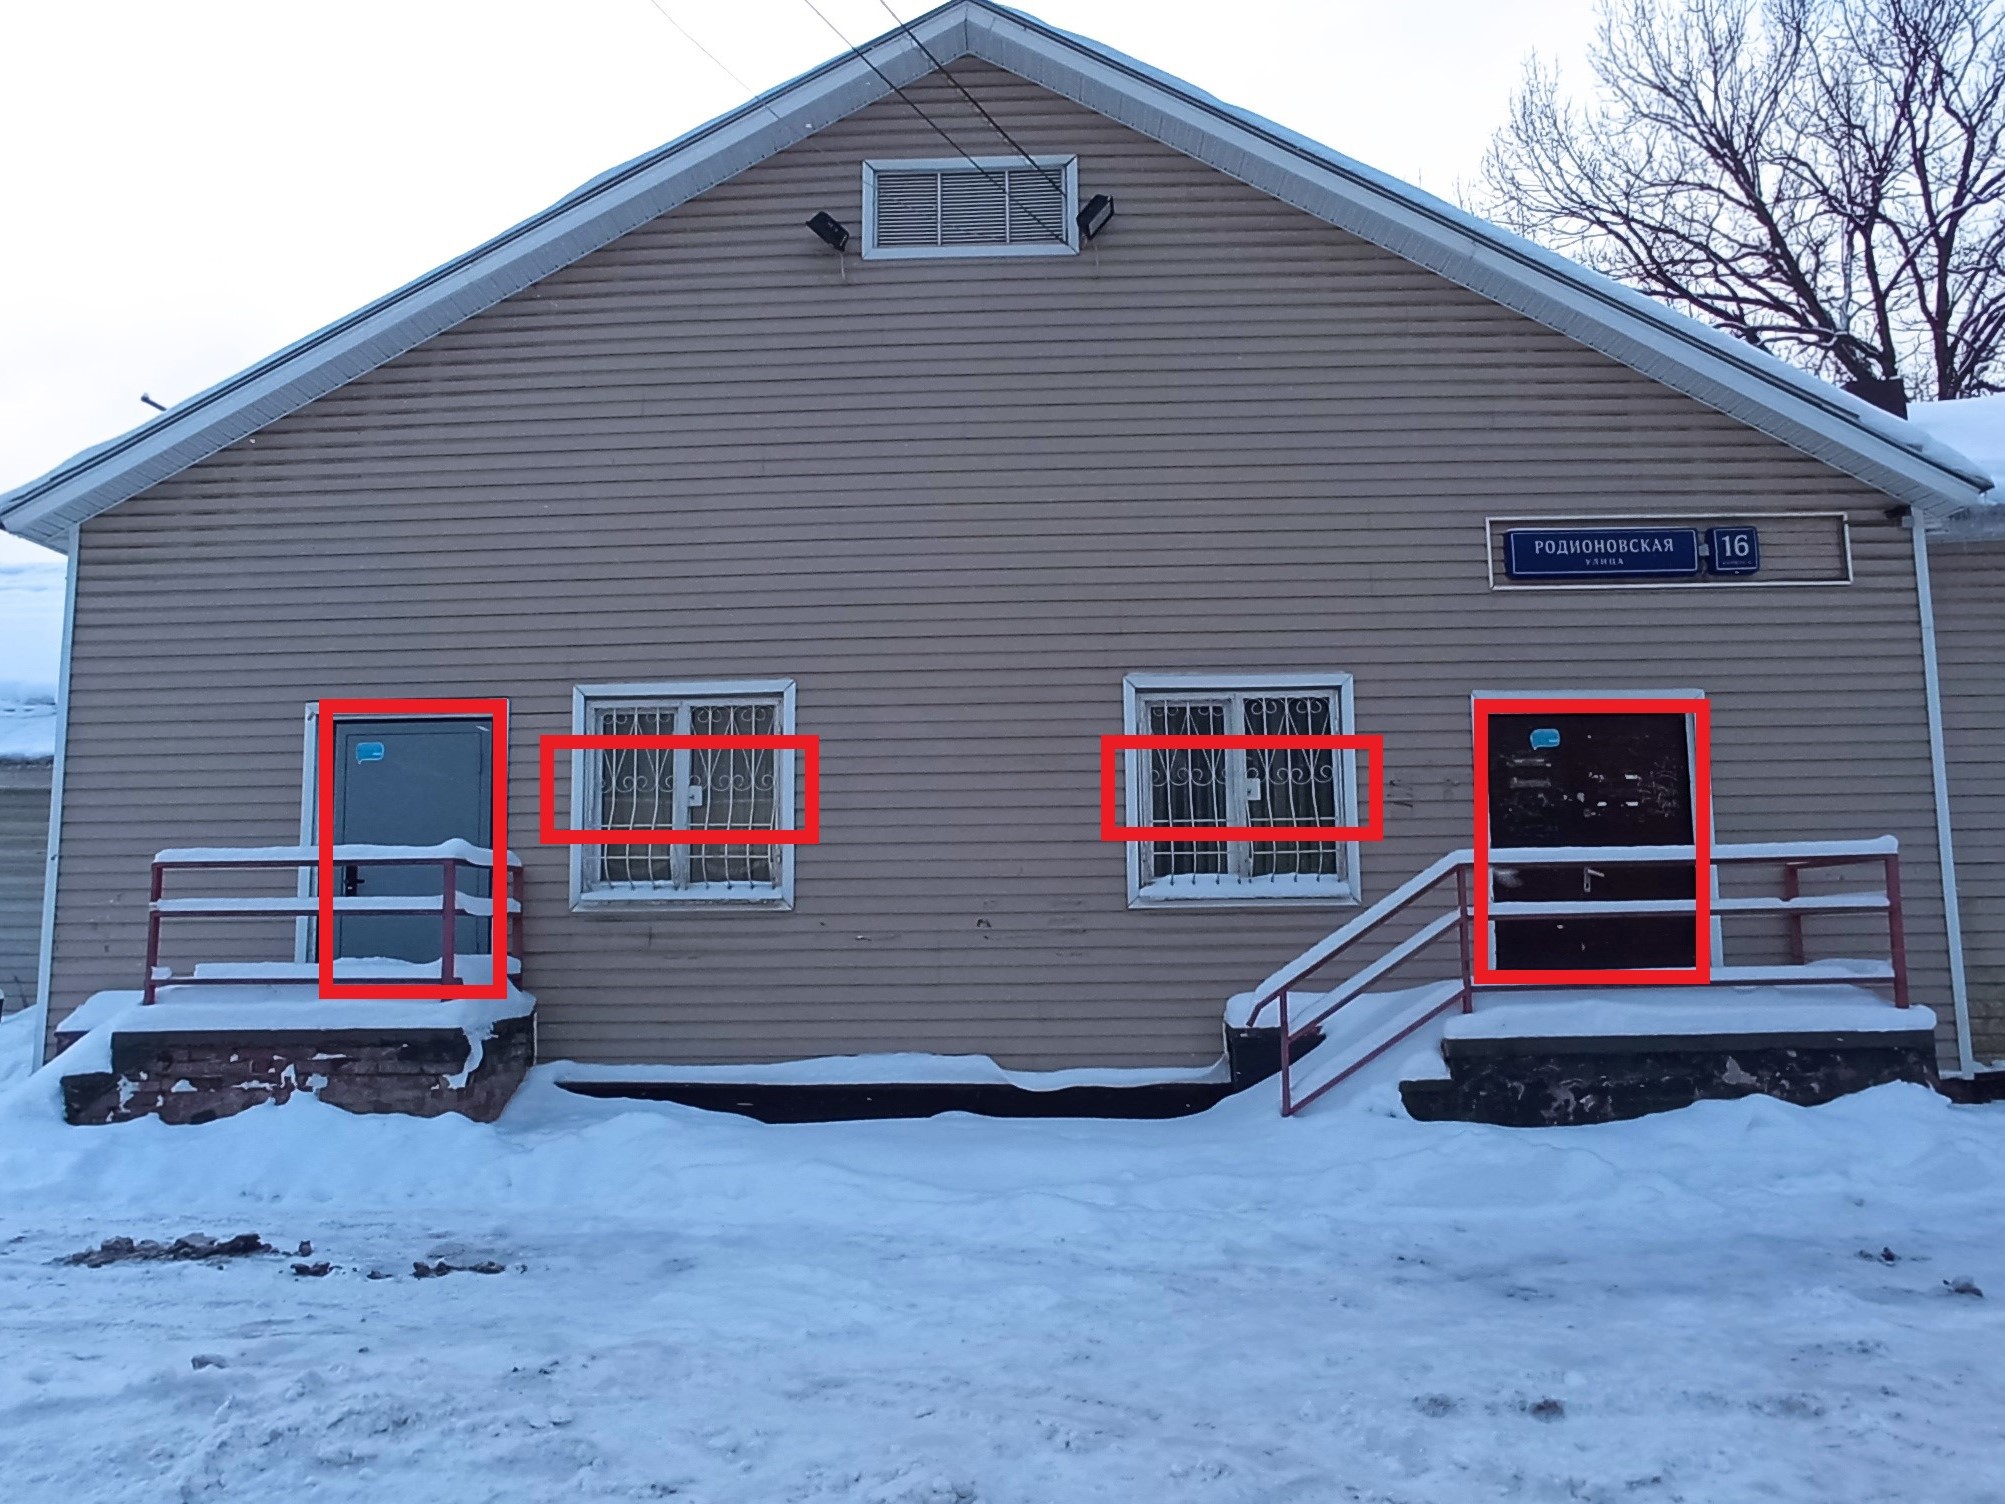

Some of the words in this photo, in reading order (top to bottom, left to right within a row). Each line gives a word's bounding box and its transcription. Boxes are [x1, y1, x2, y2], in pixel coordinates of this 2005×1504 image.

[1535, 538, 1674, 555] РОДИОНОВСКАЯ
[1721, 534, 1750, 557] 16
[1585, 557, 1624, 566] УЛИЦА
